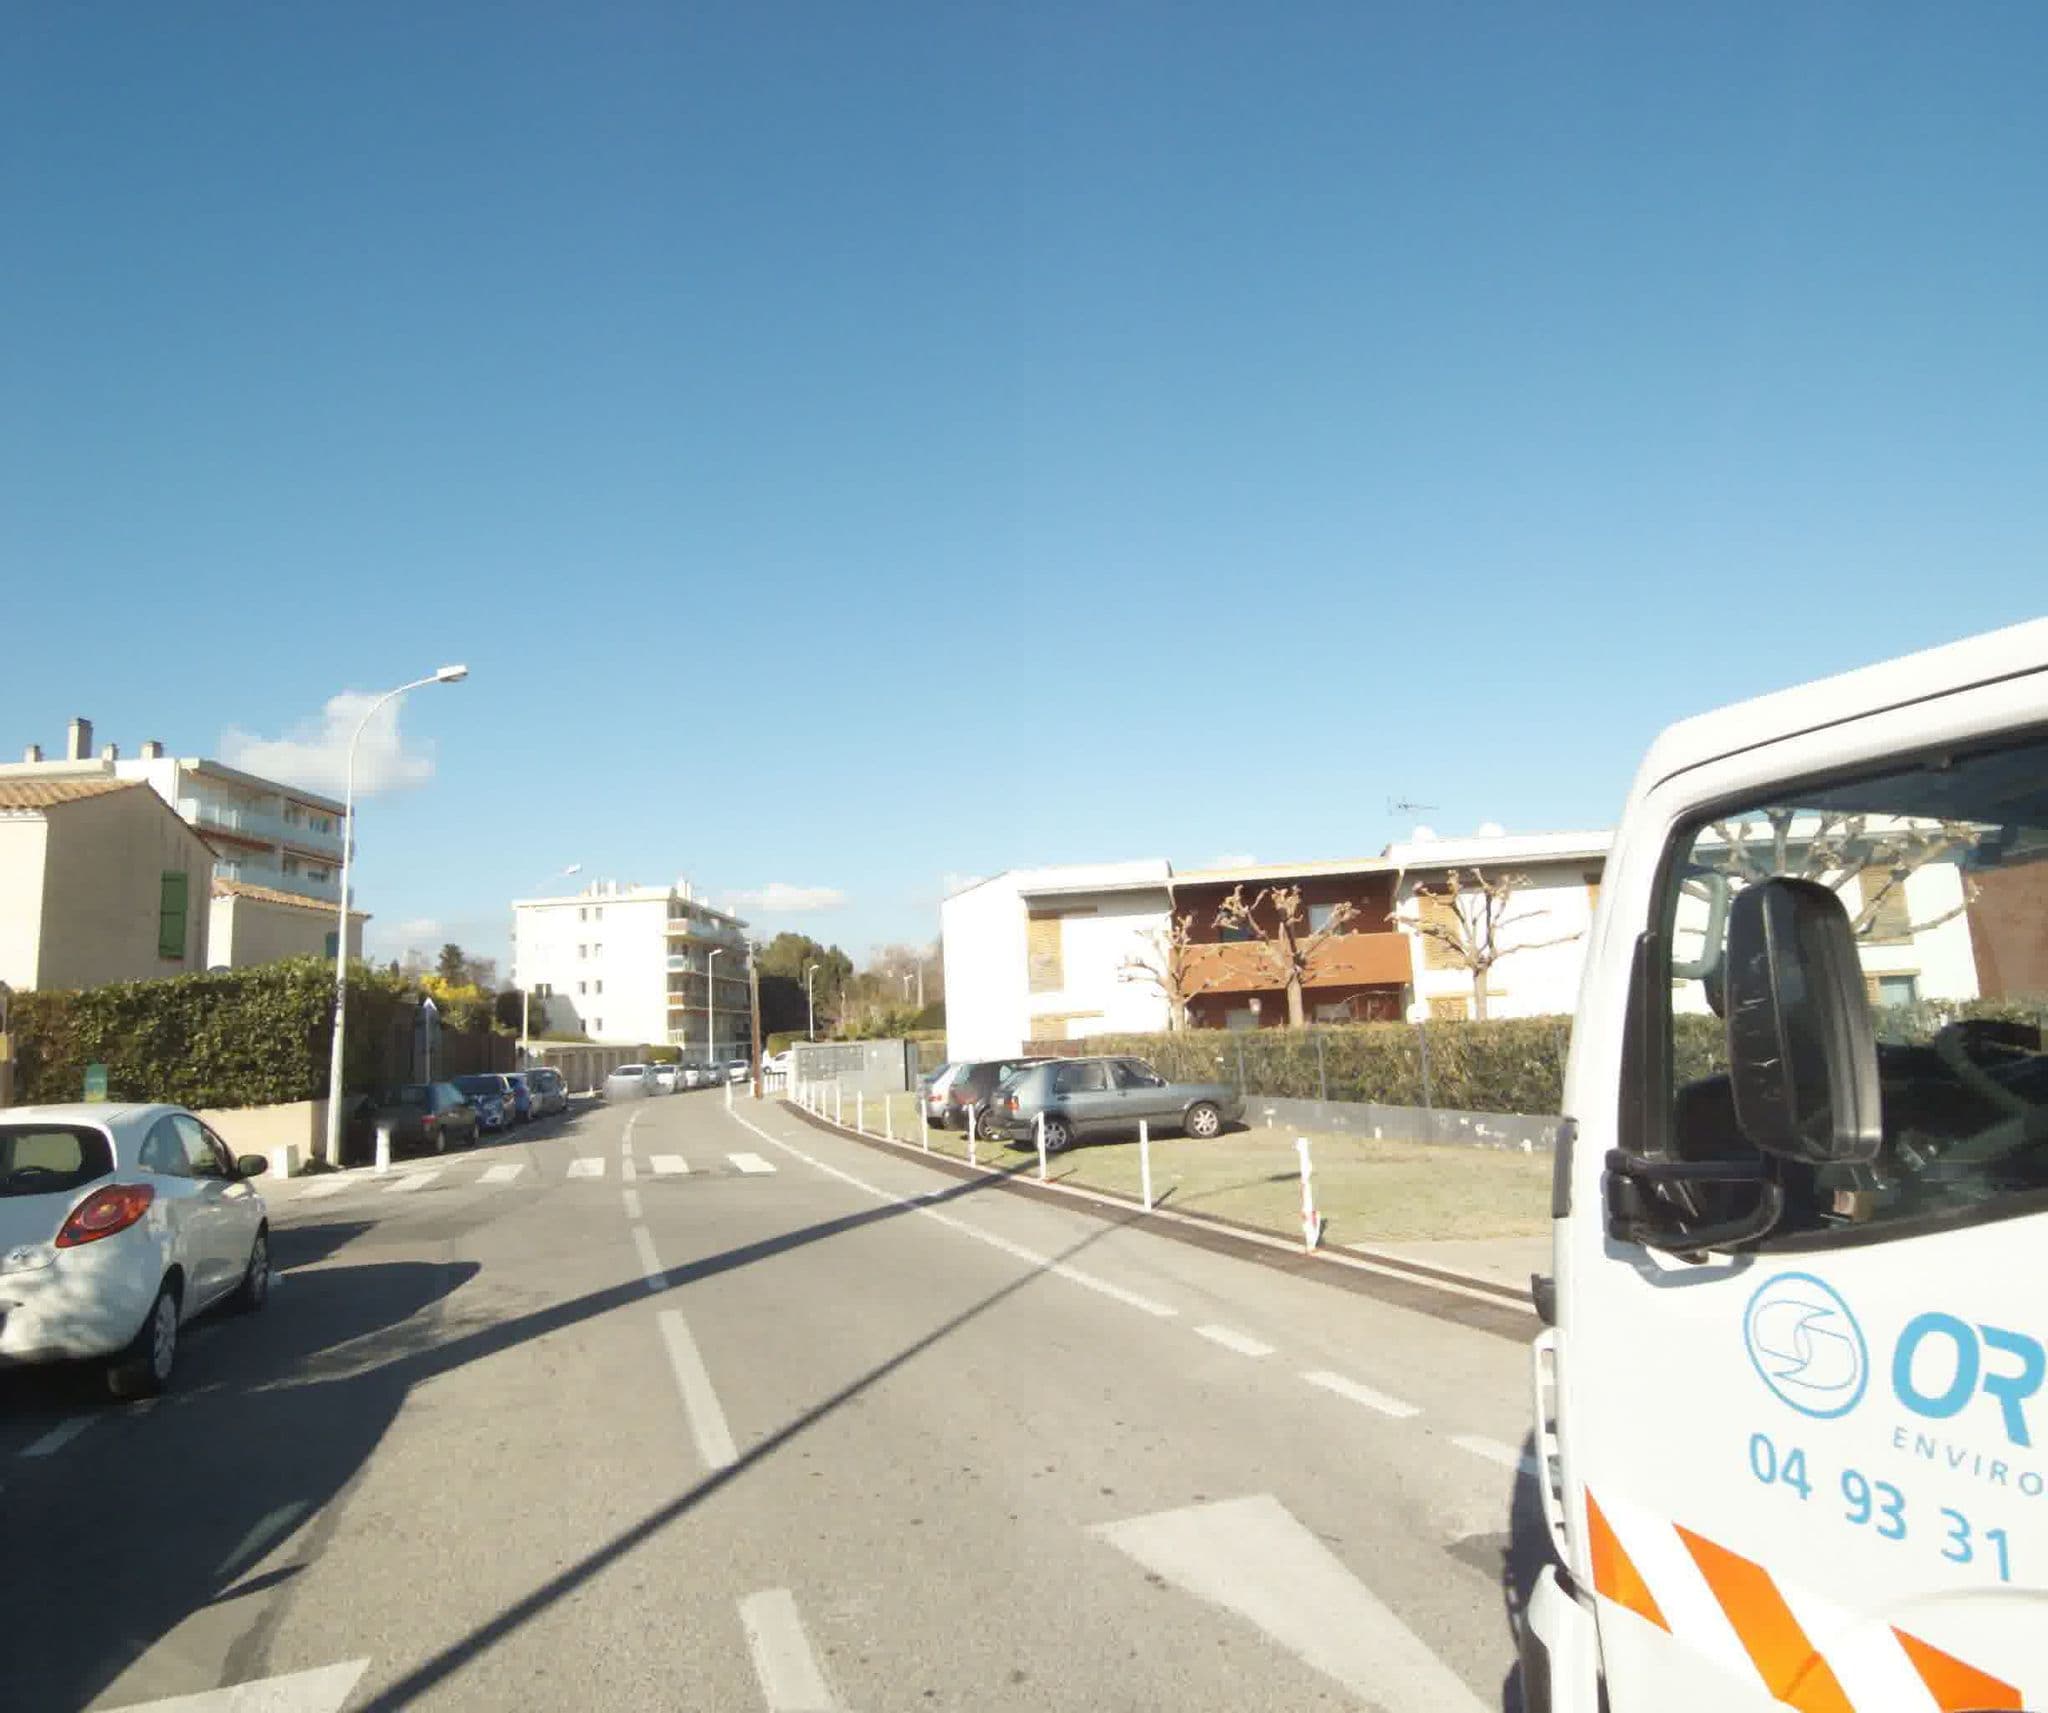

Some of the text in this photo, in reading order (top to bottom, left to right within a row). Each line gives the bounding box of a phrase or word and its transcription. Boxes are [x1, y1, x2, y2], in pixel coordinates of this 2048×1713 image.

[1891, 1311, 2047, 1448] OR
[1749, 1432, 2011, 1582] 04 93 31
[1893, 1426, 2044, 1496] ENVIRO
